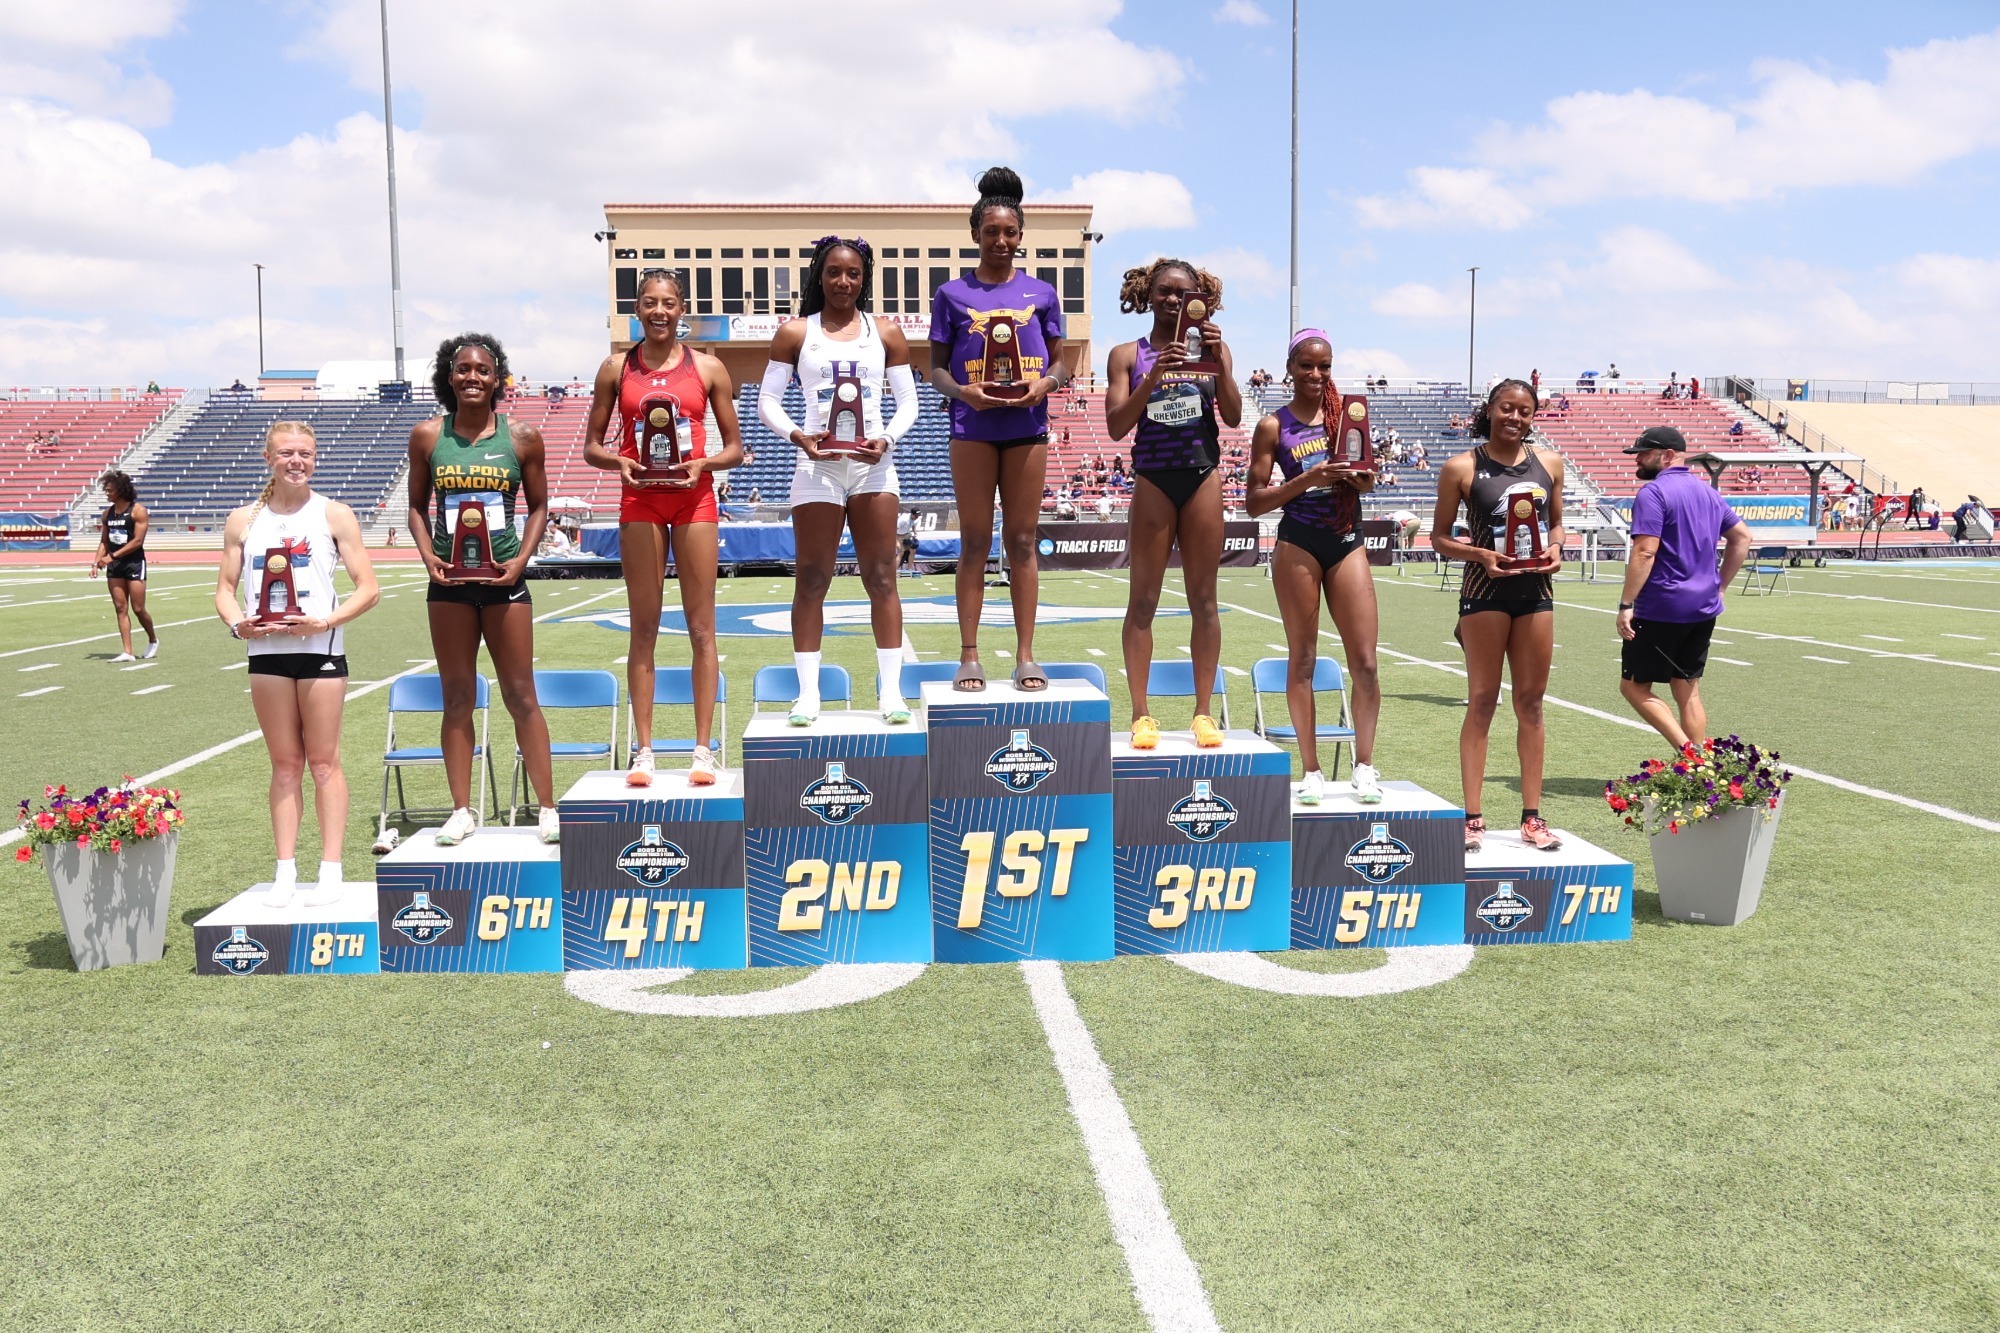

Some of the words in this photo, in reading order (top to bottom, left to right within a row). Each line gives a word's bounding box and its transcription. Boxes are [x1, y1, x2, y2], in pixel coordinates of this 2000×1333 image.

[1154, 408, 1196, 420] BREWSTER
[436, 465, 466, 476] CAL
[469, 465, 510, 479] POLY
[435, 476, 510, 491] POMONA
[1055, 540, 1089, 553] TRACK
[1090, 541, 1098, 552] &
[1099, 540, 1126, 552] FIELD
[1224, 537, 1255, 550] FIELD
[1364, 536, 1387, 549] IELD
[987, 762, 1054, 772] CHAMPIONSHIPS
[803, 795, 870, 804] CHAMPIONSHIPS
[1170, 812, 1235, 822] CHAMPIONSHIPS
[620, 857, 686, 866] CHAMPIONSHIPS
[1347, 854, 1412, 864] CHAMPIONSHIPS
[957, 828, 1089, 928] 1ST
[777, 859, 902, 931] 2ND
[1148, 864, 1256, 928] 3RD
[1561, 884, 1622, 925] 7TH
[477, 895, 553, 941] 6TH
[1335, 891, 1422, 943] 5TH
[604, 897, 705, 958] 4TH
[310, 932, 365, 966] 8TH
